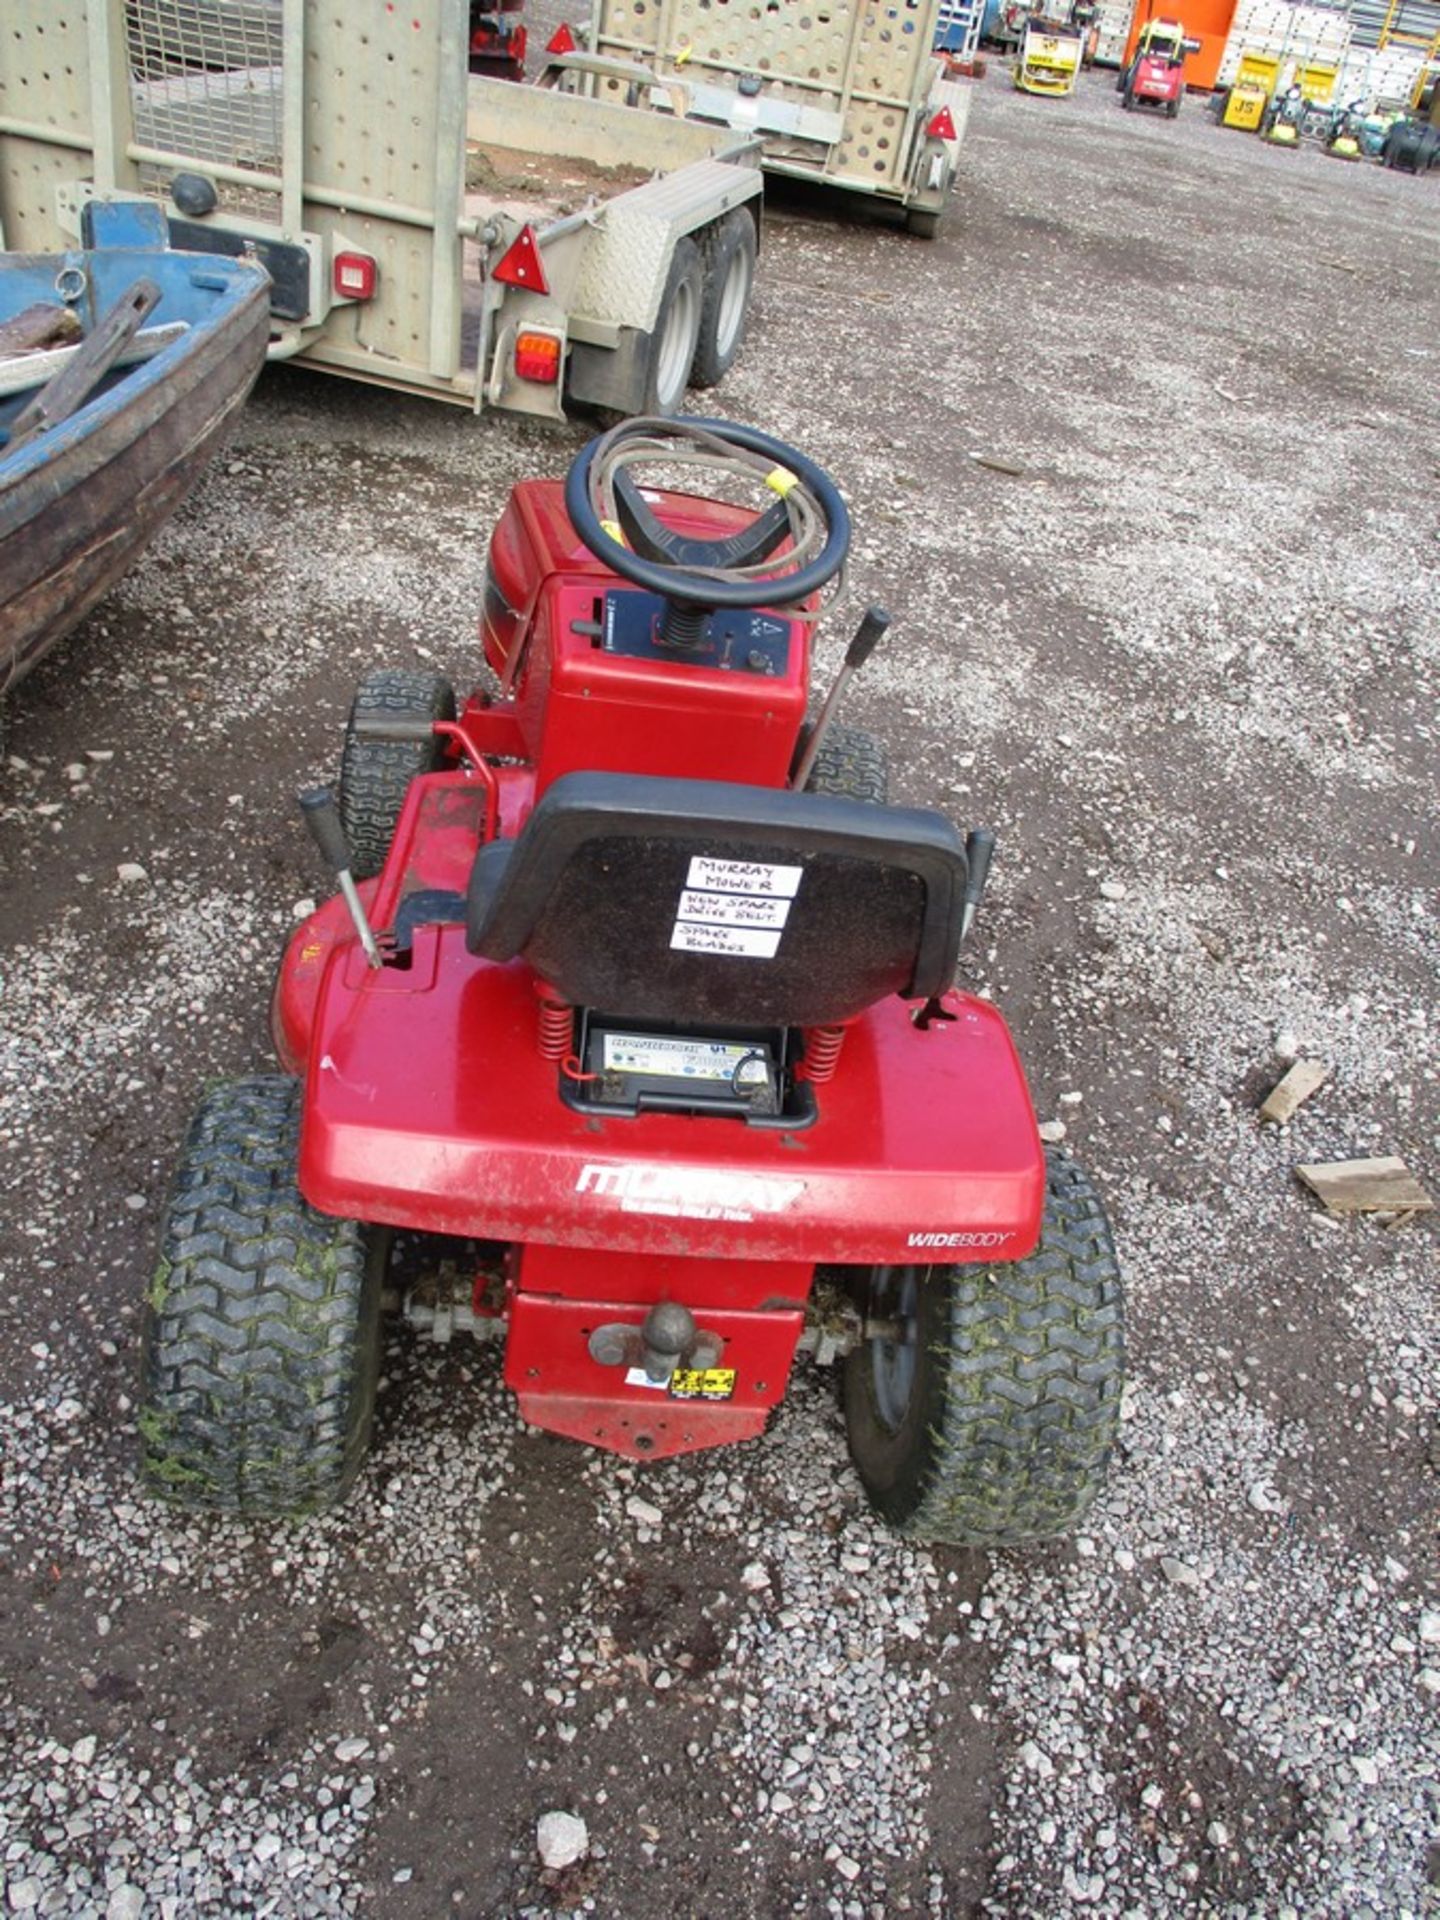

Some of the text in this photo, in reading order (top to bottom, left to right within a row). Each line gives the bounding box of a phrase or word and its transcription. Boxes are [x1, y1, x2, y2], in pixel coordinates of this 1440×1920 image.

[699, 860, 773, 877] MURRAY
[705, 875, 773, 891] MOWER
[687, 894, 778, 911] NEW SPARE
[684, 904, 726, 918] DRIVE
[680, 924, 730, 939] SPARE
[686, 937, 745, 952] BLADES
[907, 1231, 1011, 1247] WIDEBODY
